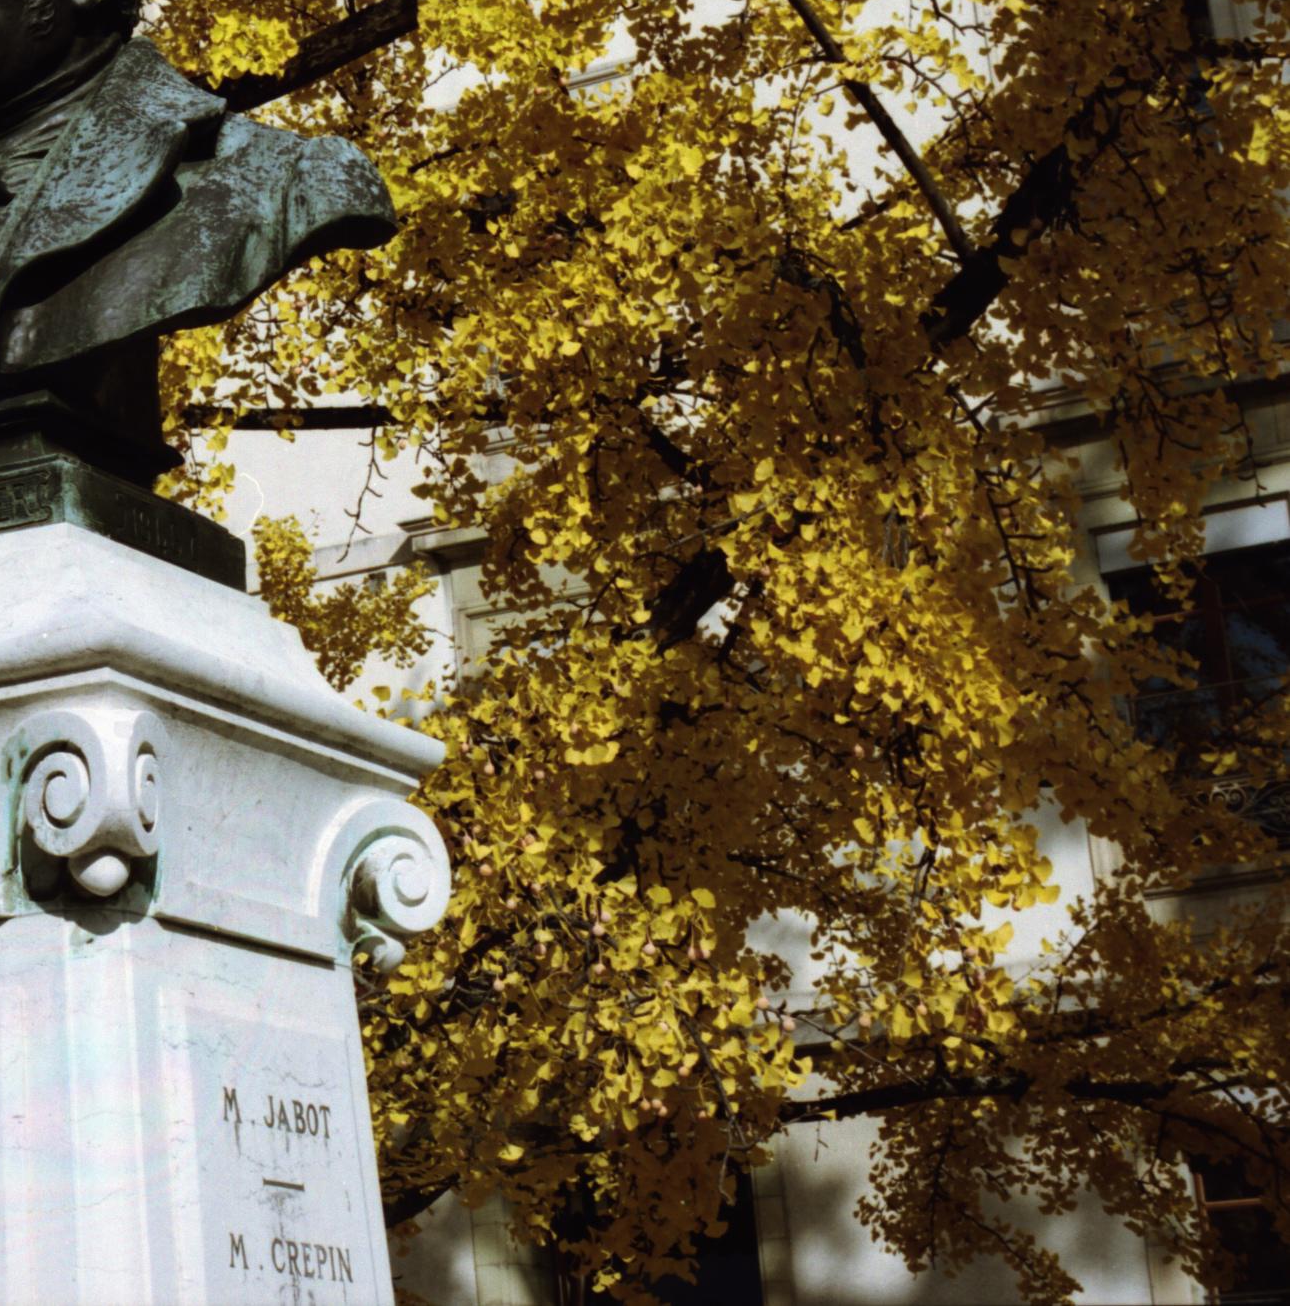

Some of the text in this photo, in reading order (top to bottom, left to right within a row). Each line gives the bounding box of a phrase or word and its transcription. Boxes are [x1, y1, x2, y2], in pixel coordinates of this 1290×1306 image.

[222, 1085, 331, 1139] M. JABOT
[229, 1232, 354, 1283] M. CREPIN
